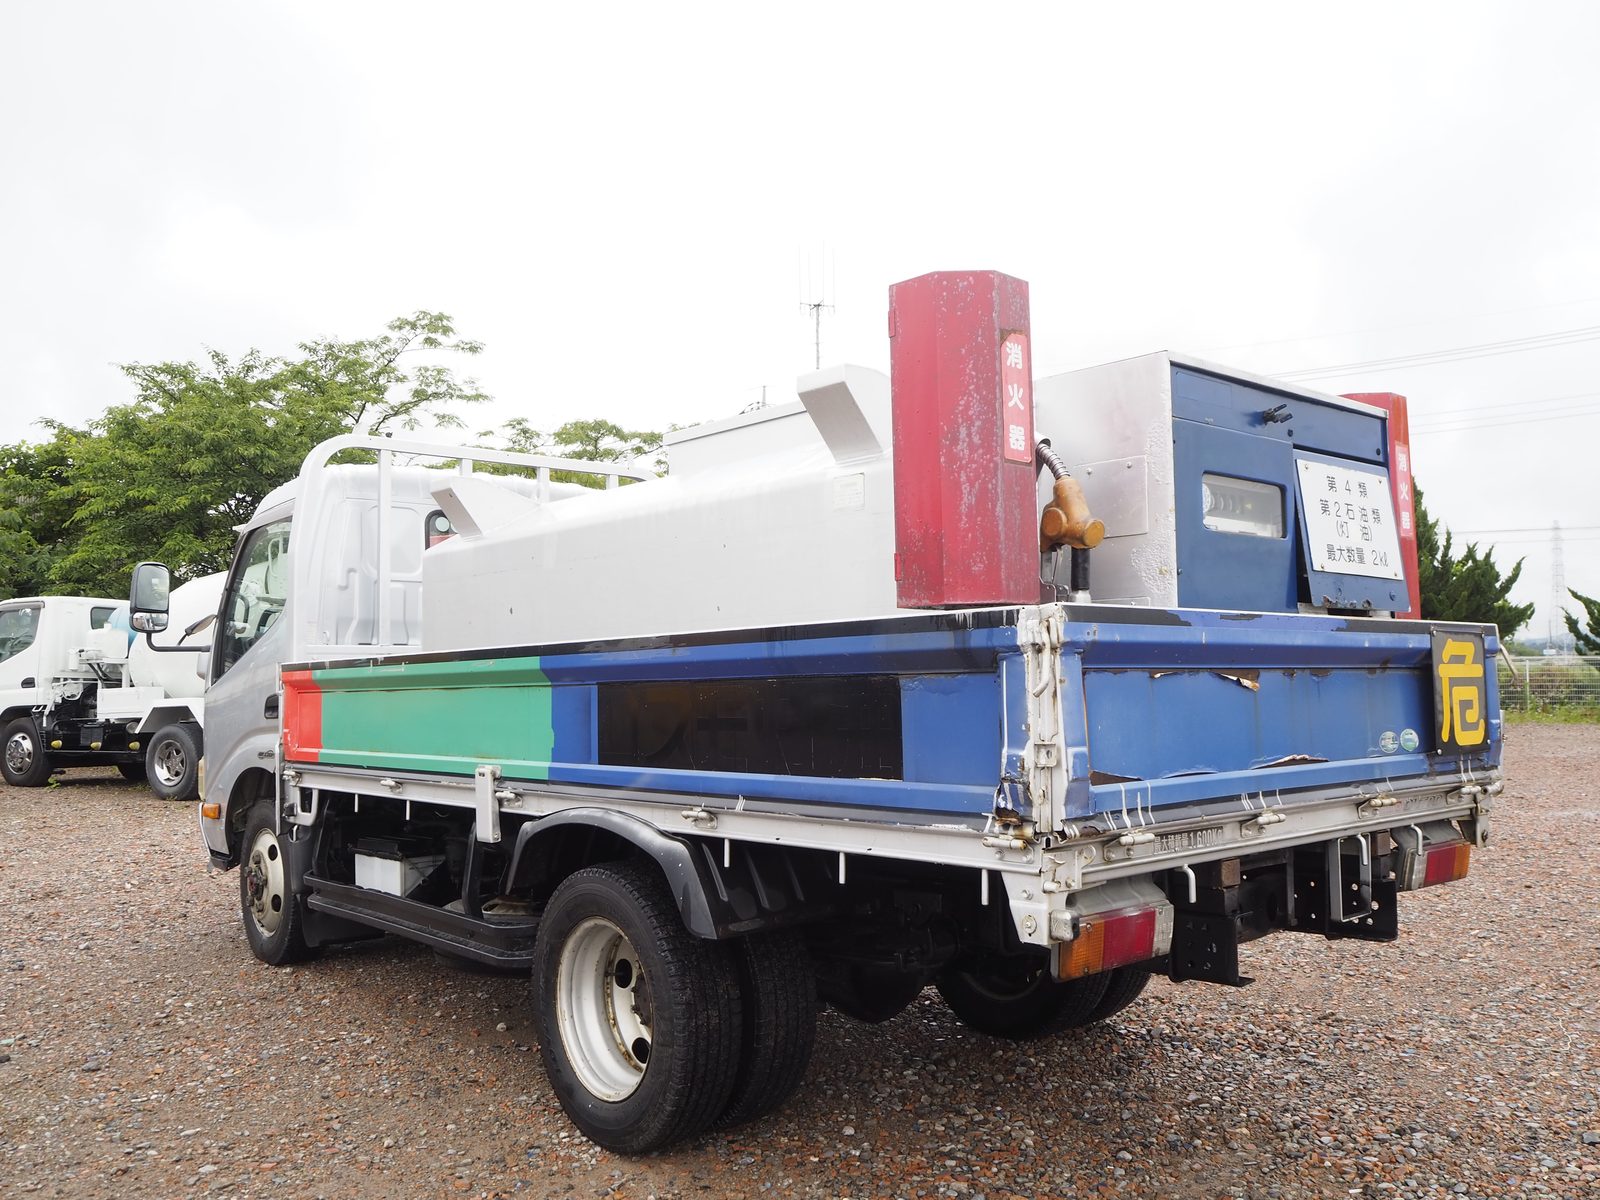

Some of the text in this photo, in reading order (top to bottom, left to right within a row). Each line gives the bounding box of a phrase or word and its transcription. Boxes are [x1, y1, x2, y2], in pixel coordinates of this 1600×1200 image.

[1006, 340, 1026, 451] 消火器
[1399, 452, 1411, 530] 消火器
[1438, 638, 1486, 746] 危
